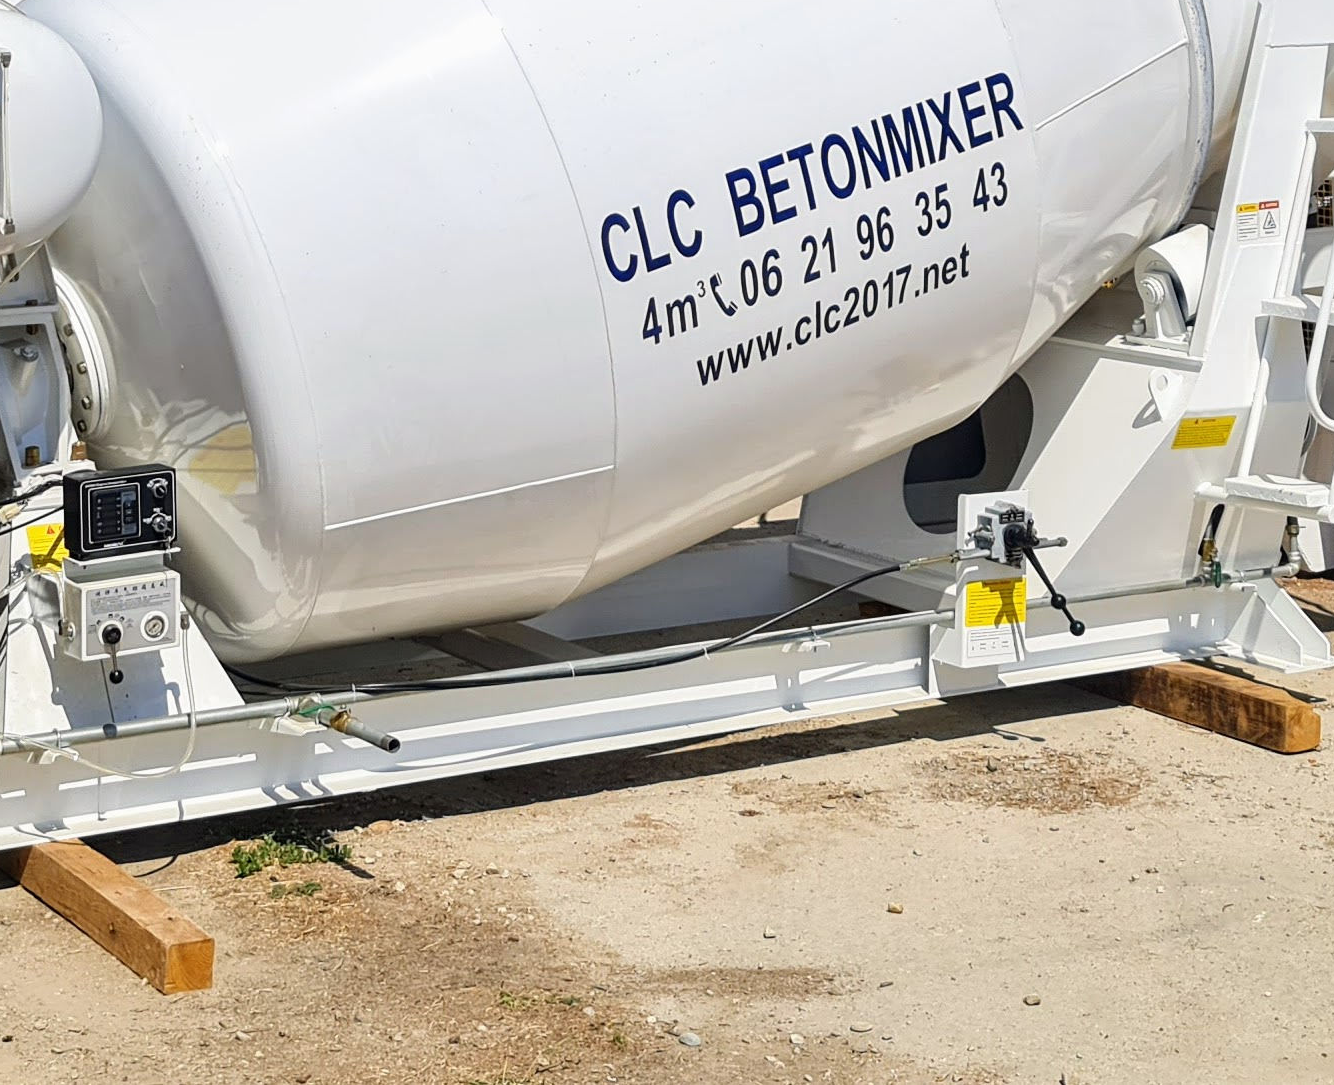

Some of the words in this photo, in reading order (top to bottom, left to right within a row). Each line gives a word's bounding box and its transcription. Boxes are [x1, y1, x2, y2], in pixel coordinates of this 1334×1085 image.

[600, 189, 703, 282] CLC
[725, 72, 1025, 237] BETONMIXER
[740, 249, 783, 306] 06
[801, 227, 838, 284] 21
[857, 207, 894, 260] 96
[915, 183, 952, 236] 35
[973, 162, 1008, 212] 43
[697, 243, 970, 386] www.clc2017.net
